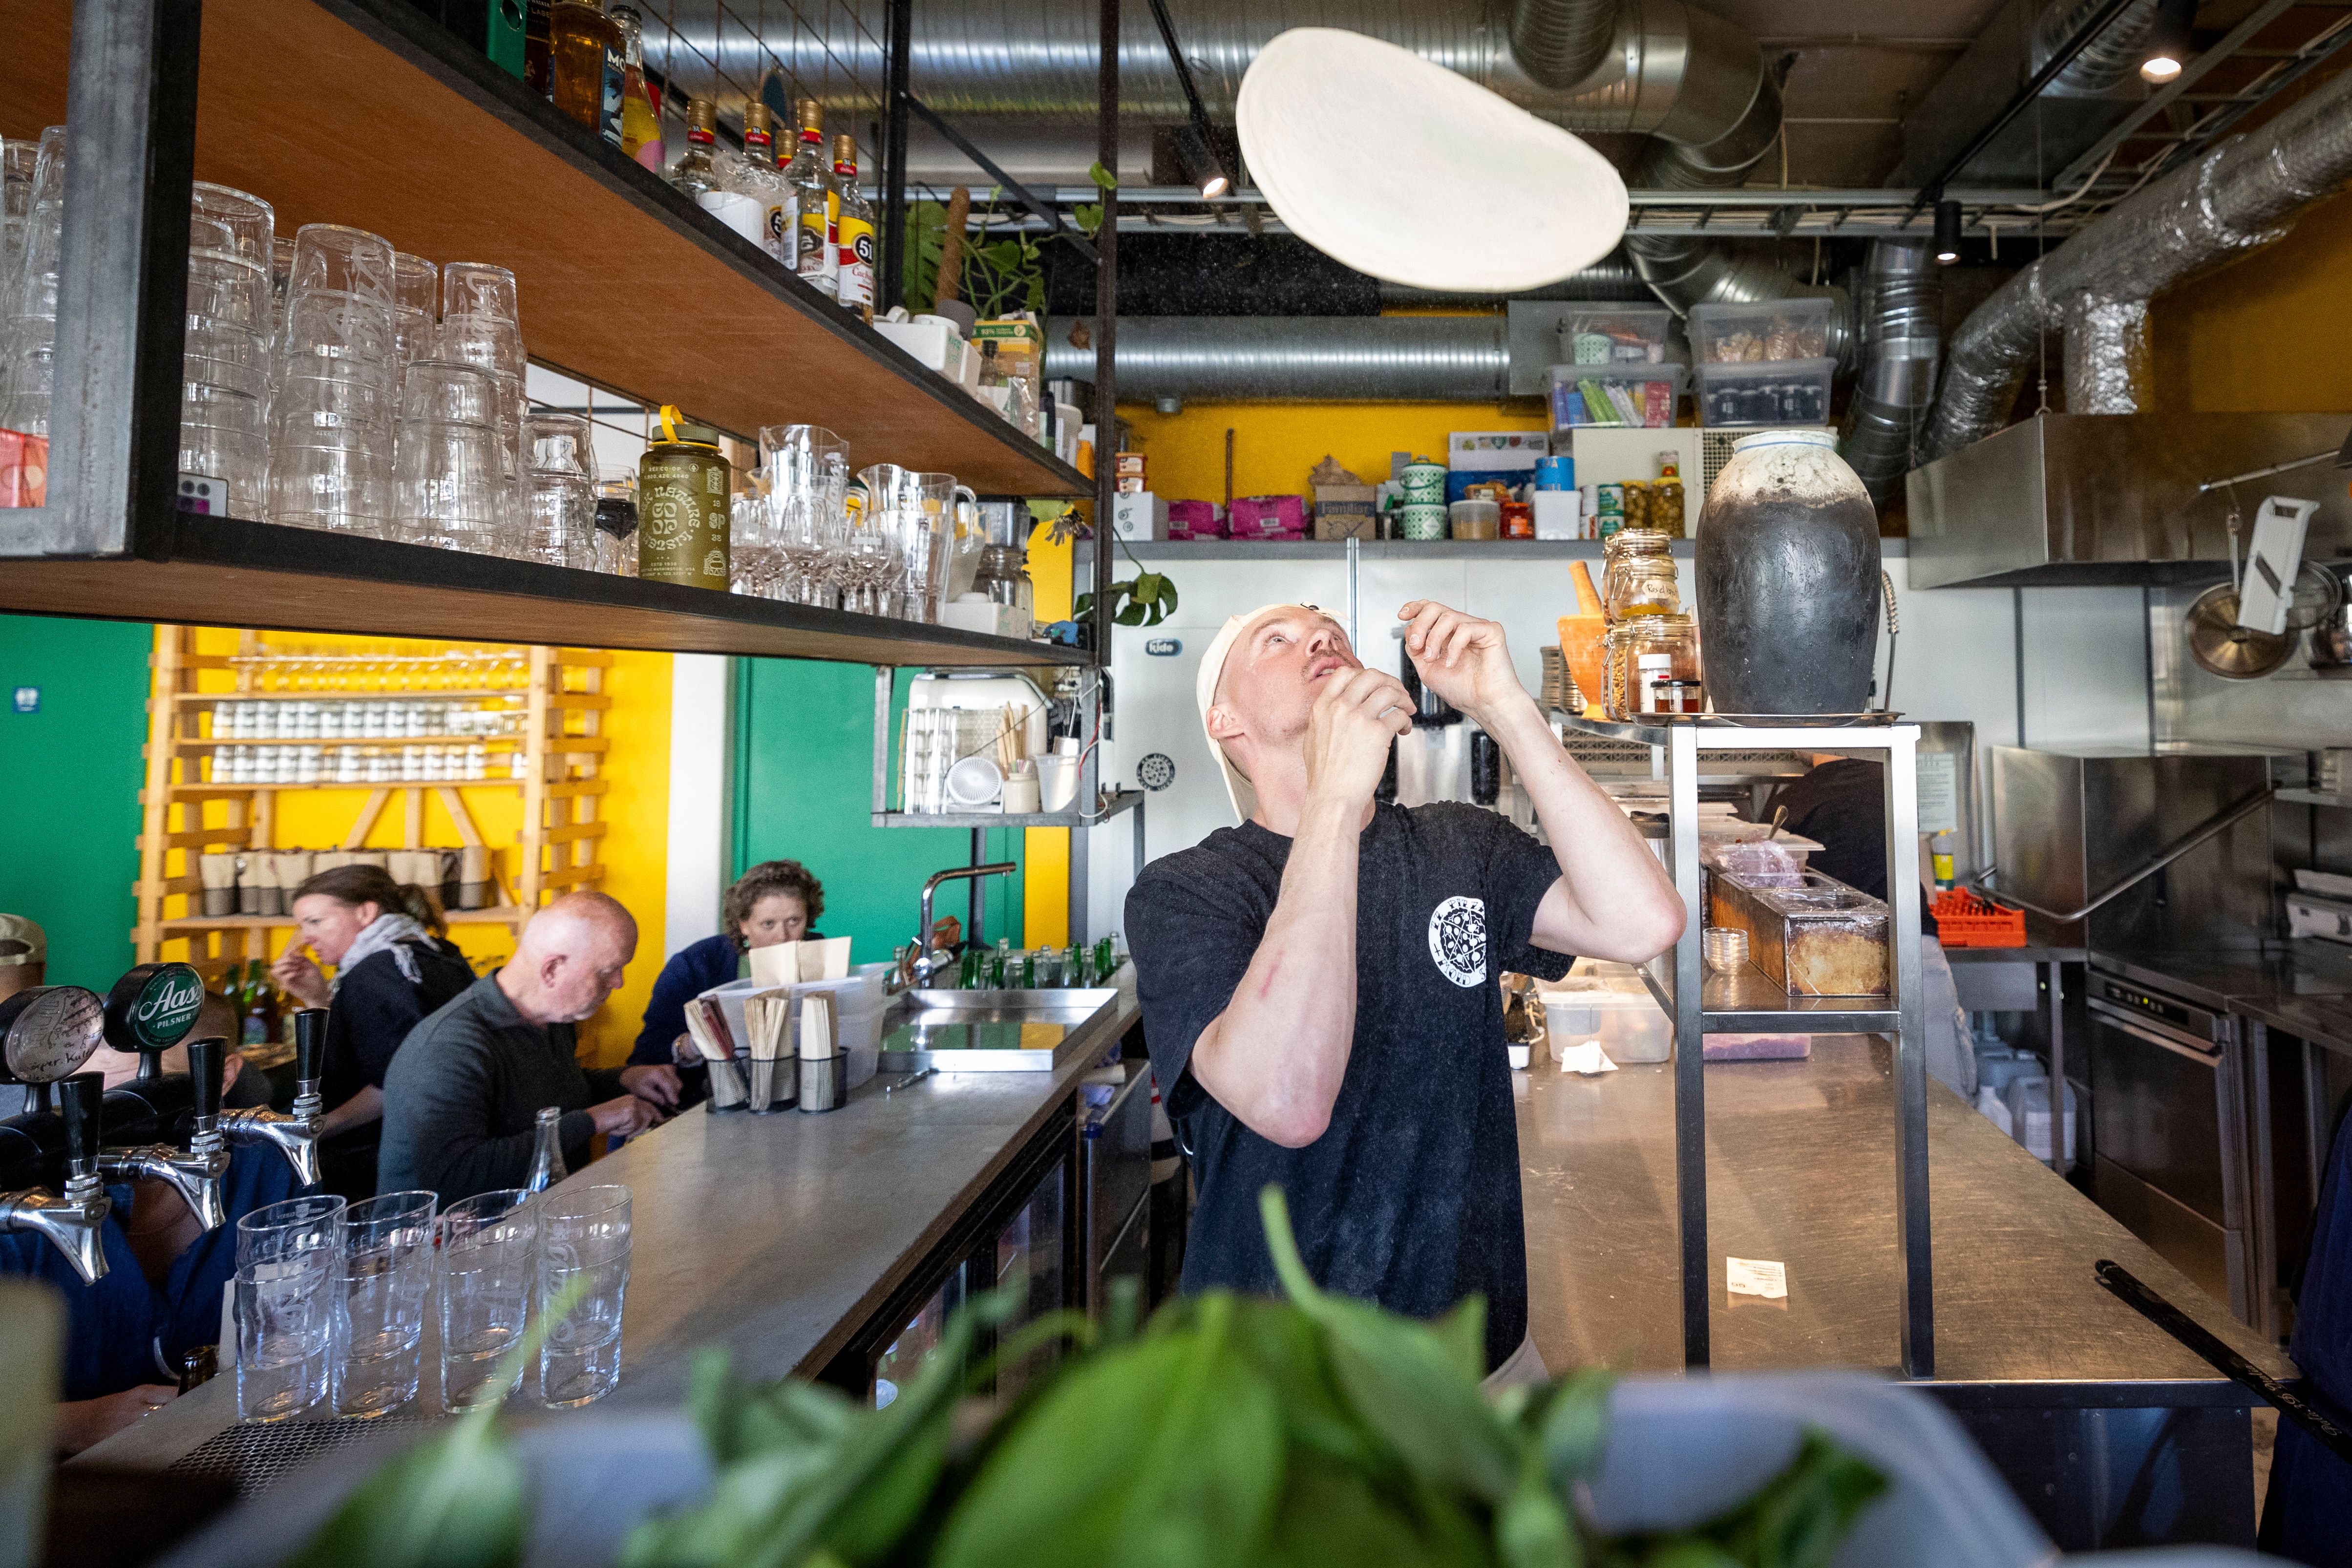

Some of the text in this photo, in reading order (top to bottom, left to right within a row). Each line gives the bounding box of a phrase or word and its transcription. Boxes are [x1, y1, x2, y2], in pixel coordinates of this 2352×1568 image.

[531, 8, 550, 18] LABE
[858, 239, 872, 260] 51
[654, 486, 700, 528] NATURE
[157, 1013, 191, 1029] PILSNER
